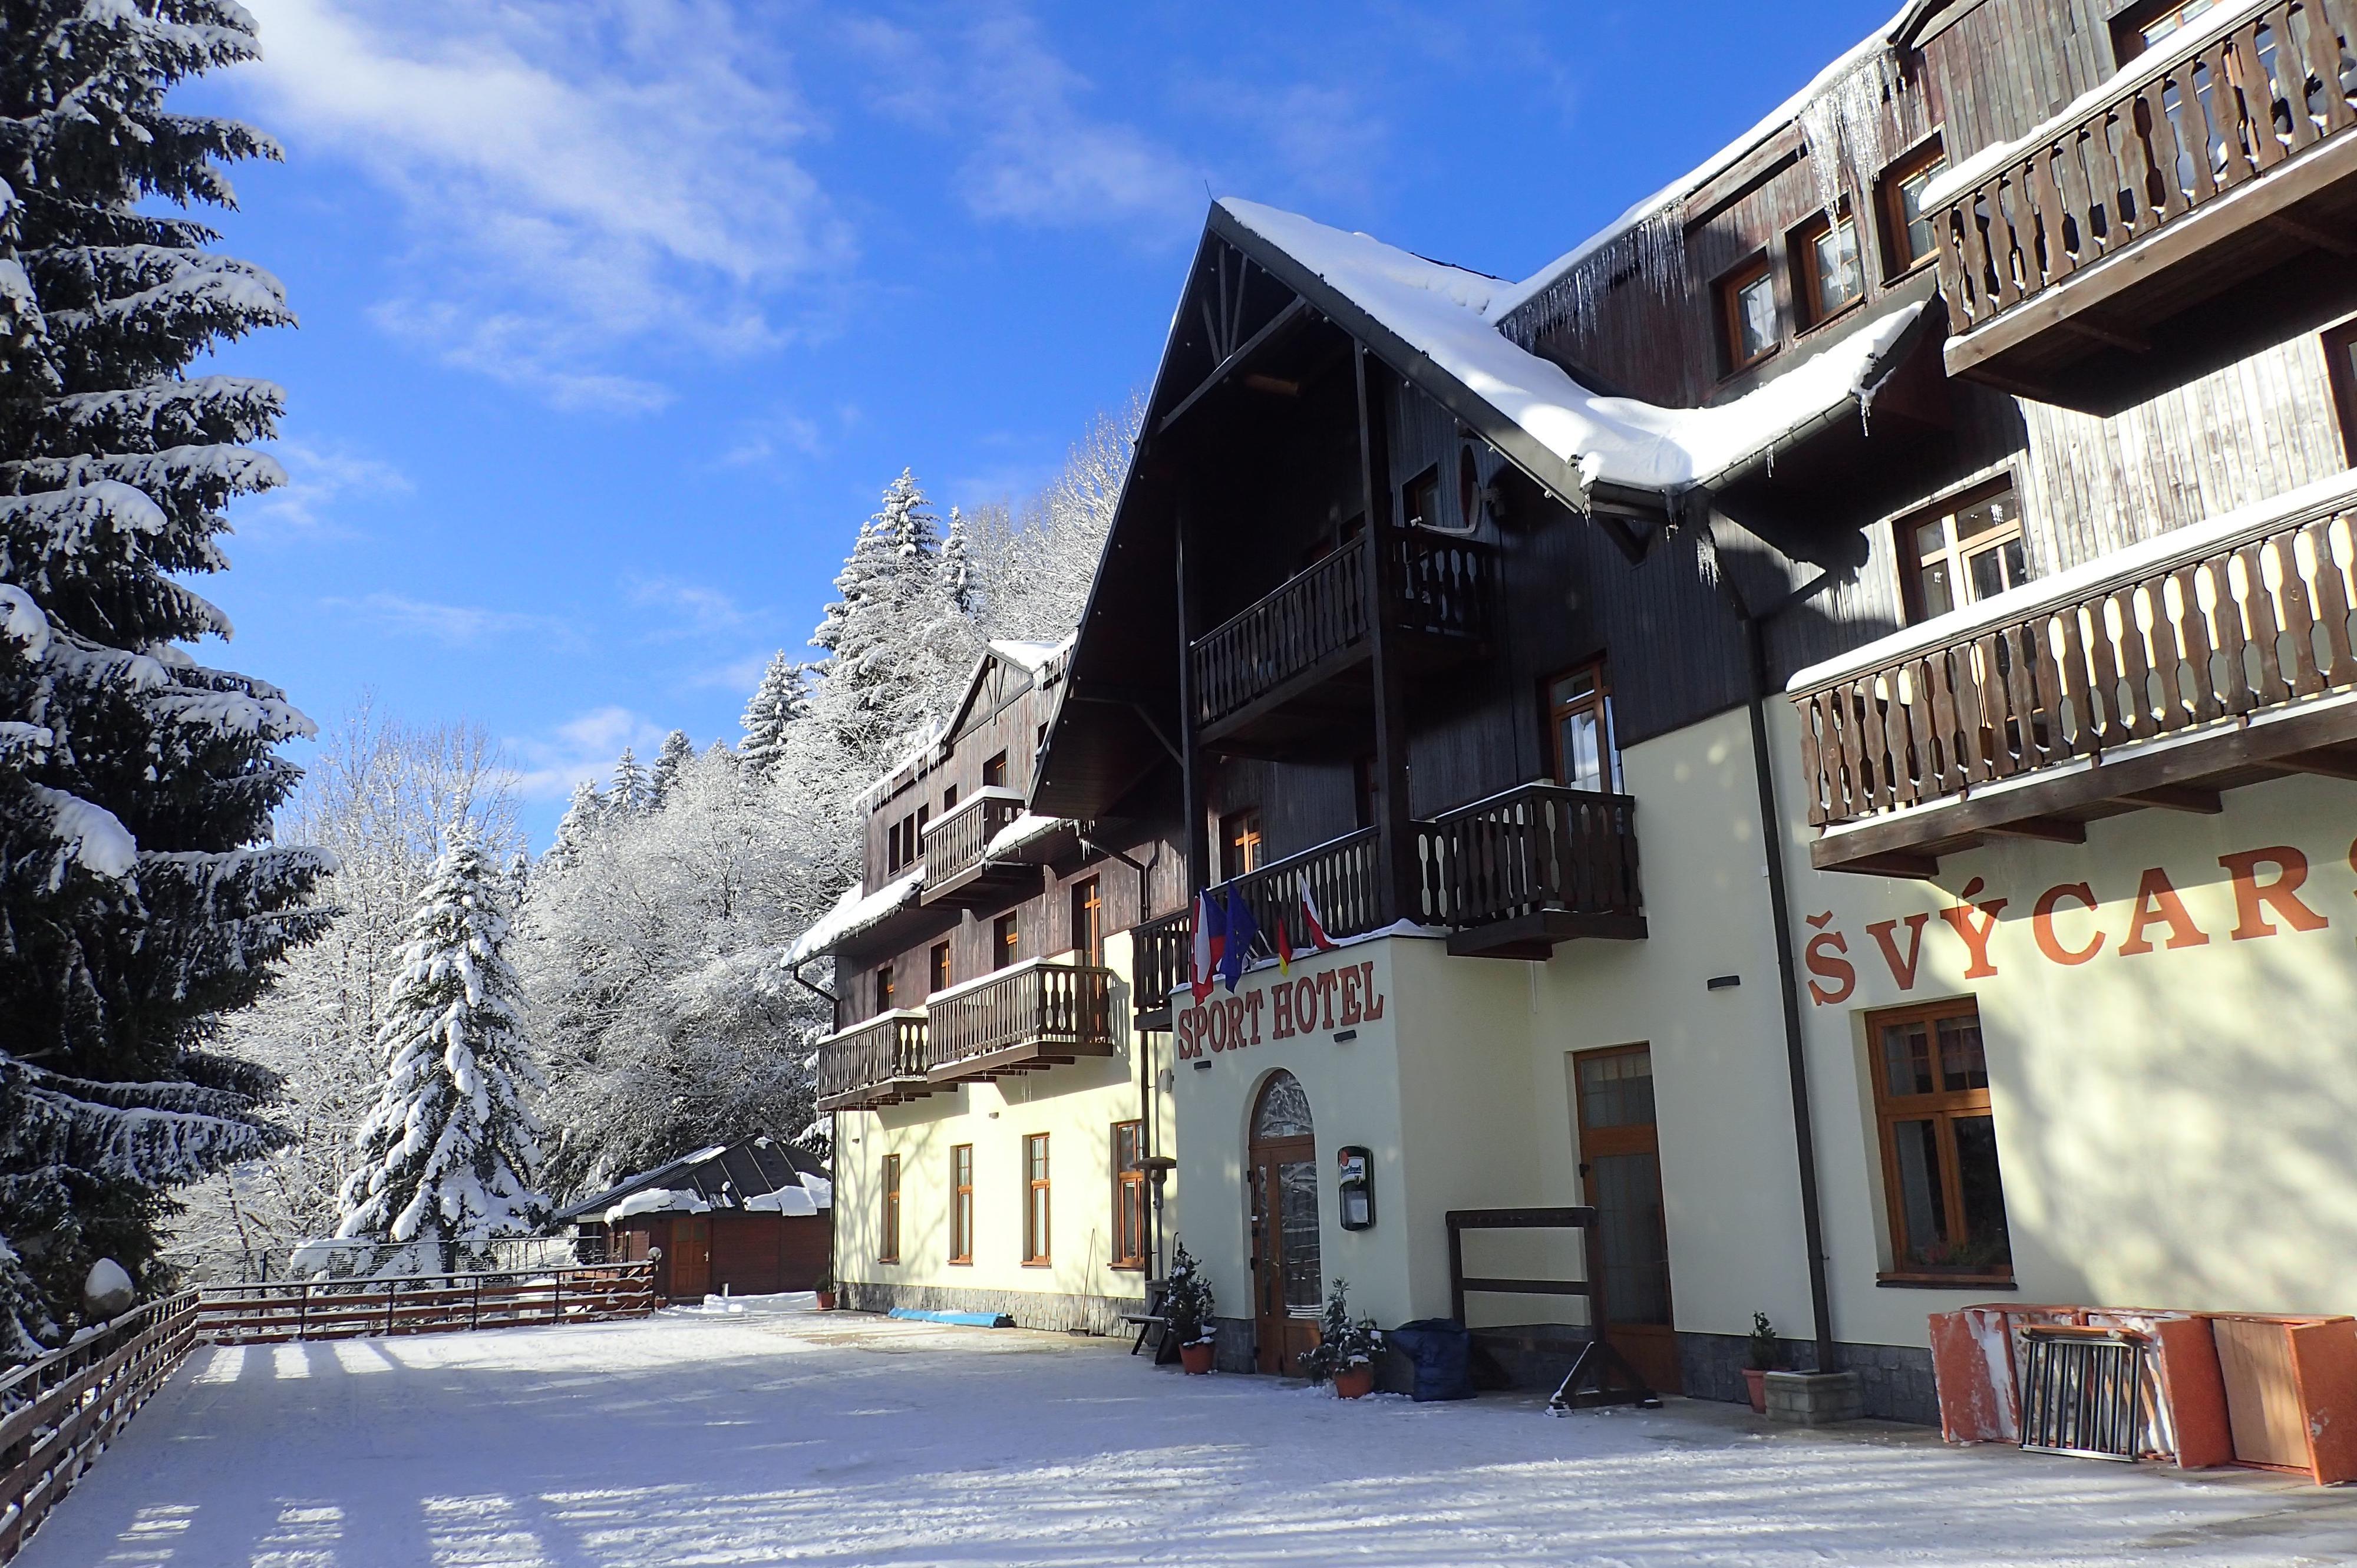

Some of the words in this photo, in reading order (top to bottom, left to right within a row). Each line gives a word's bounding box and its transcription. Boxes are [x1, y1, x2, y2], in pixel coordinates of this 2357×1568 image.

[1805, 836, 2357, 1006] ŠVÝCAR
[1178, 989, 1264, 1059] SPORT
[1271, 961, 1384, 1040] HOTEL
